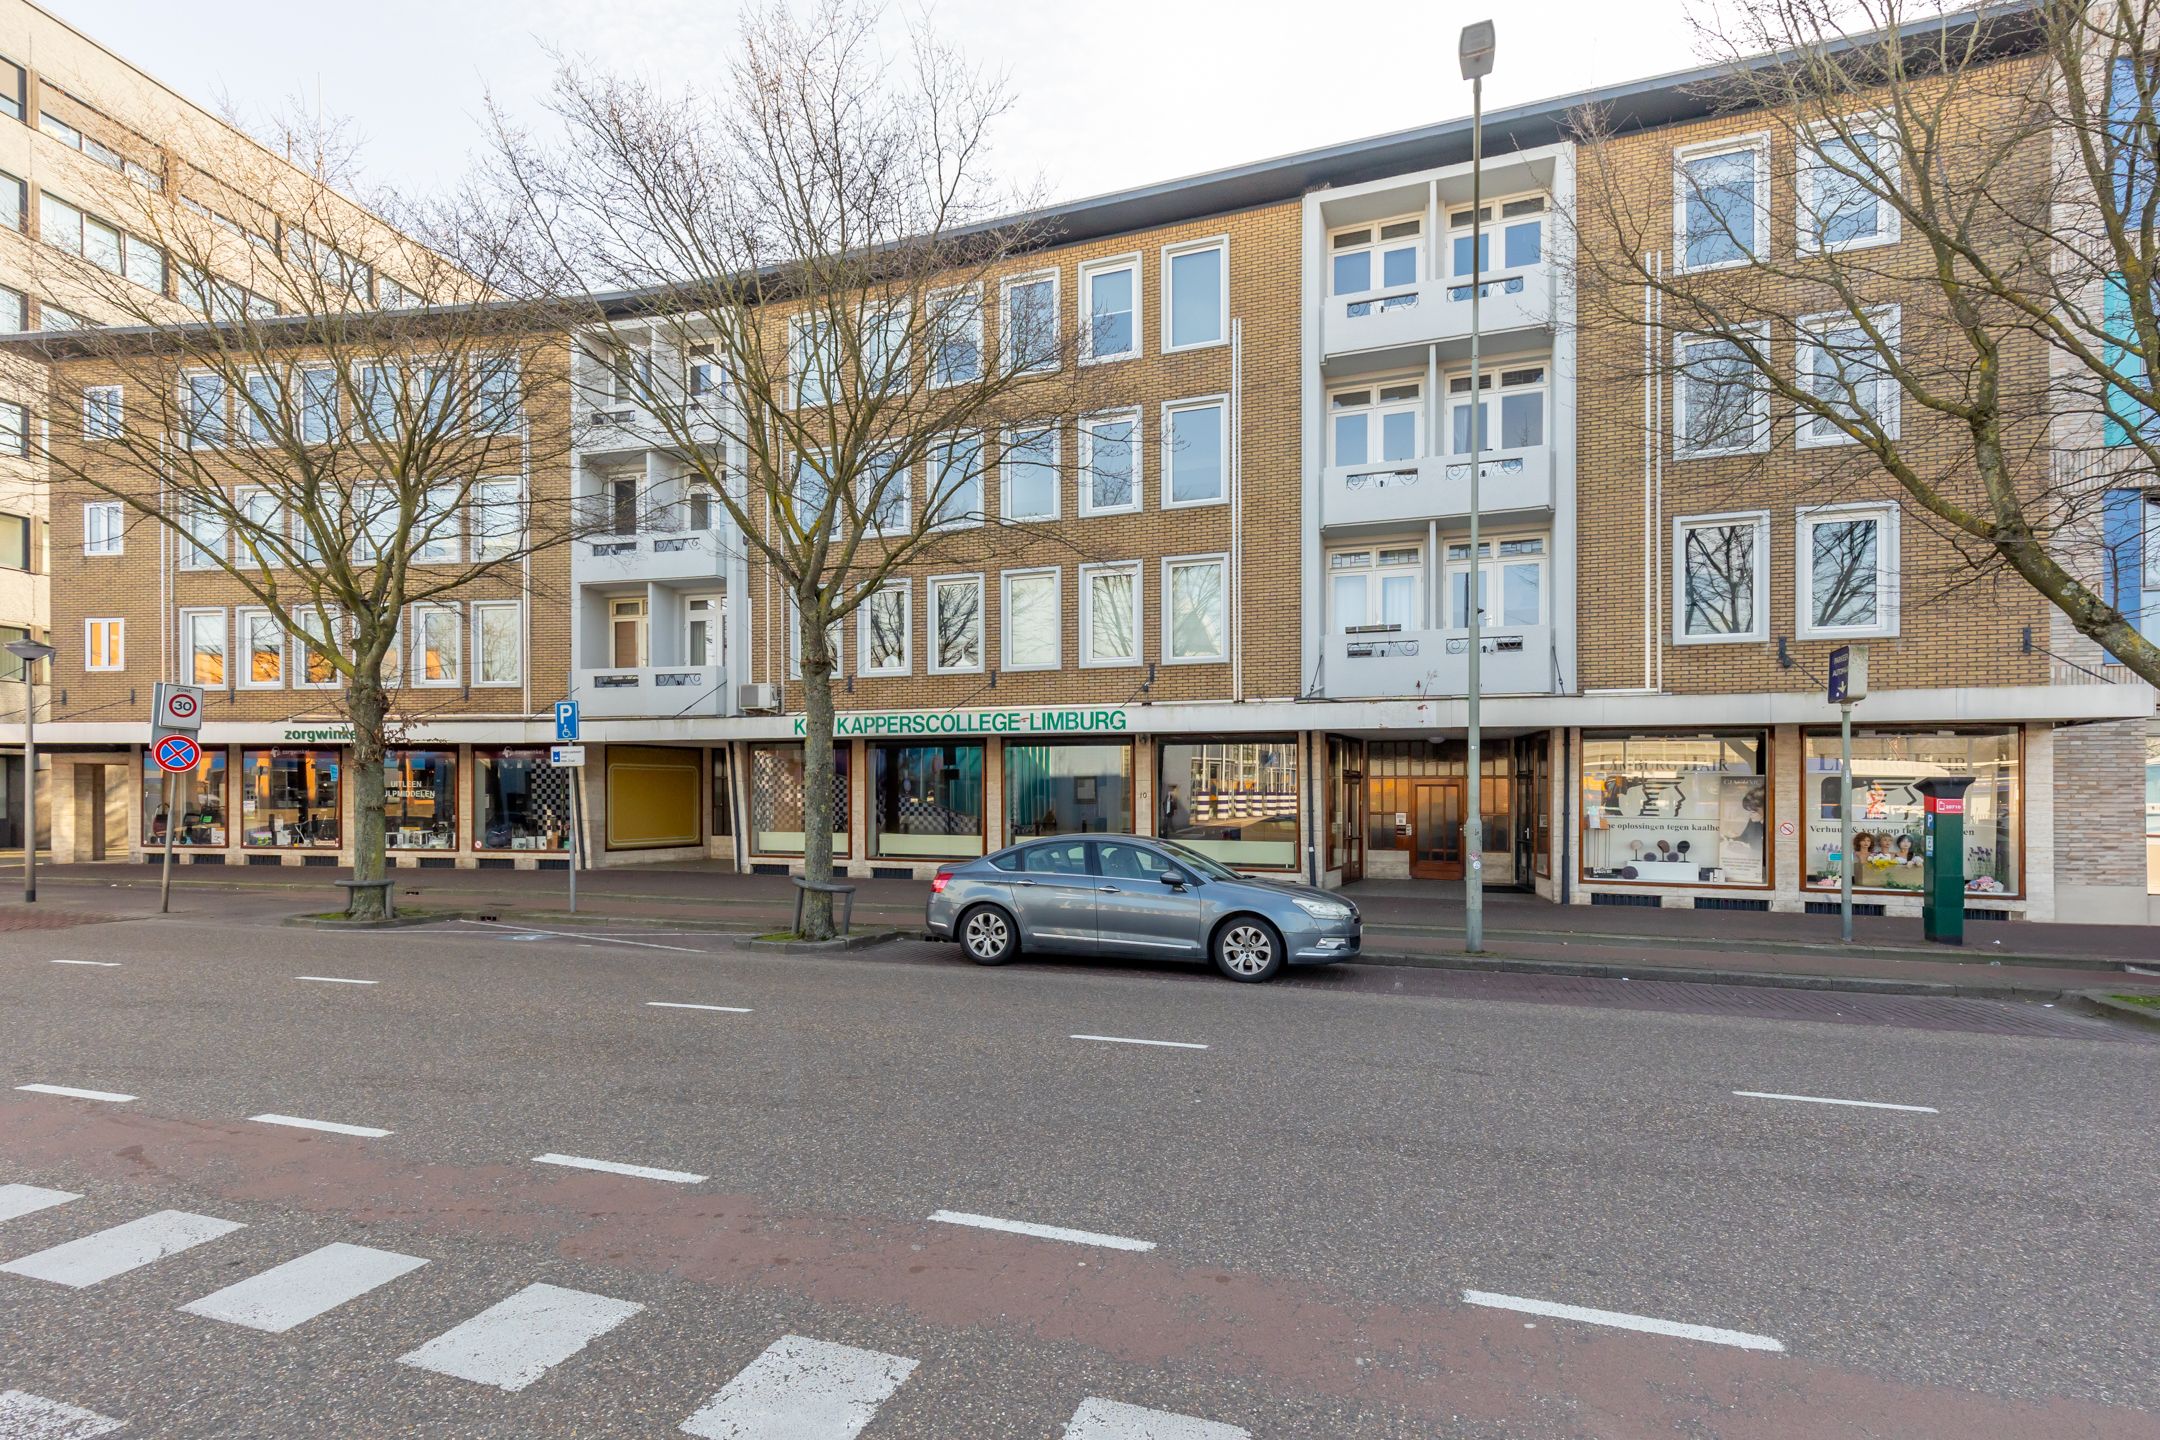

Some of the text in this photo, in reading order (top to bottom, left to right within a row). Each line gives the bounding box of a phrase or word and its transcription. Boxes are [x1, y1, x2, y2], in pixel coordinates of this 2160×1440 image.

[174, 700, 192, 711] 30
[560, 704, 573, 724] P
[837, 712, 1021, 735] KAPPERSCOLLEGE
[1029, 710, 1127, 731] LIMBURG
[284, 726, 356, 742] zorgwinke
[390, 780, 422, 788] UITLEEN
[384, 790, 436, 798] ULPMIDDELEN
[1927, 814, 1934, 828] P
[1617, 823, 1665, 832] oplossingen
[1666, 824, 1689, 832] tegen
[1691, 824, 1720, 832] kaalhe
[1810, 825, 1842, 833] Verhuu
[1850, 826, 1858, 834] &
